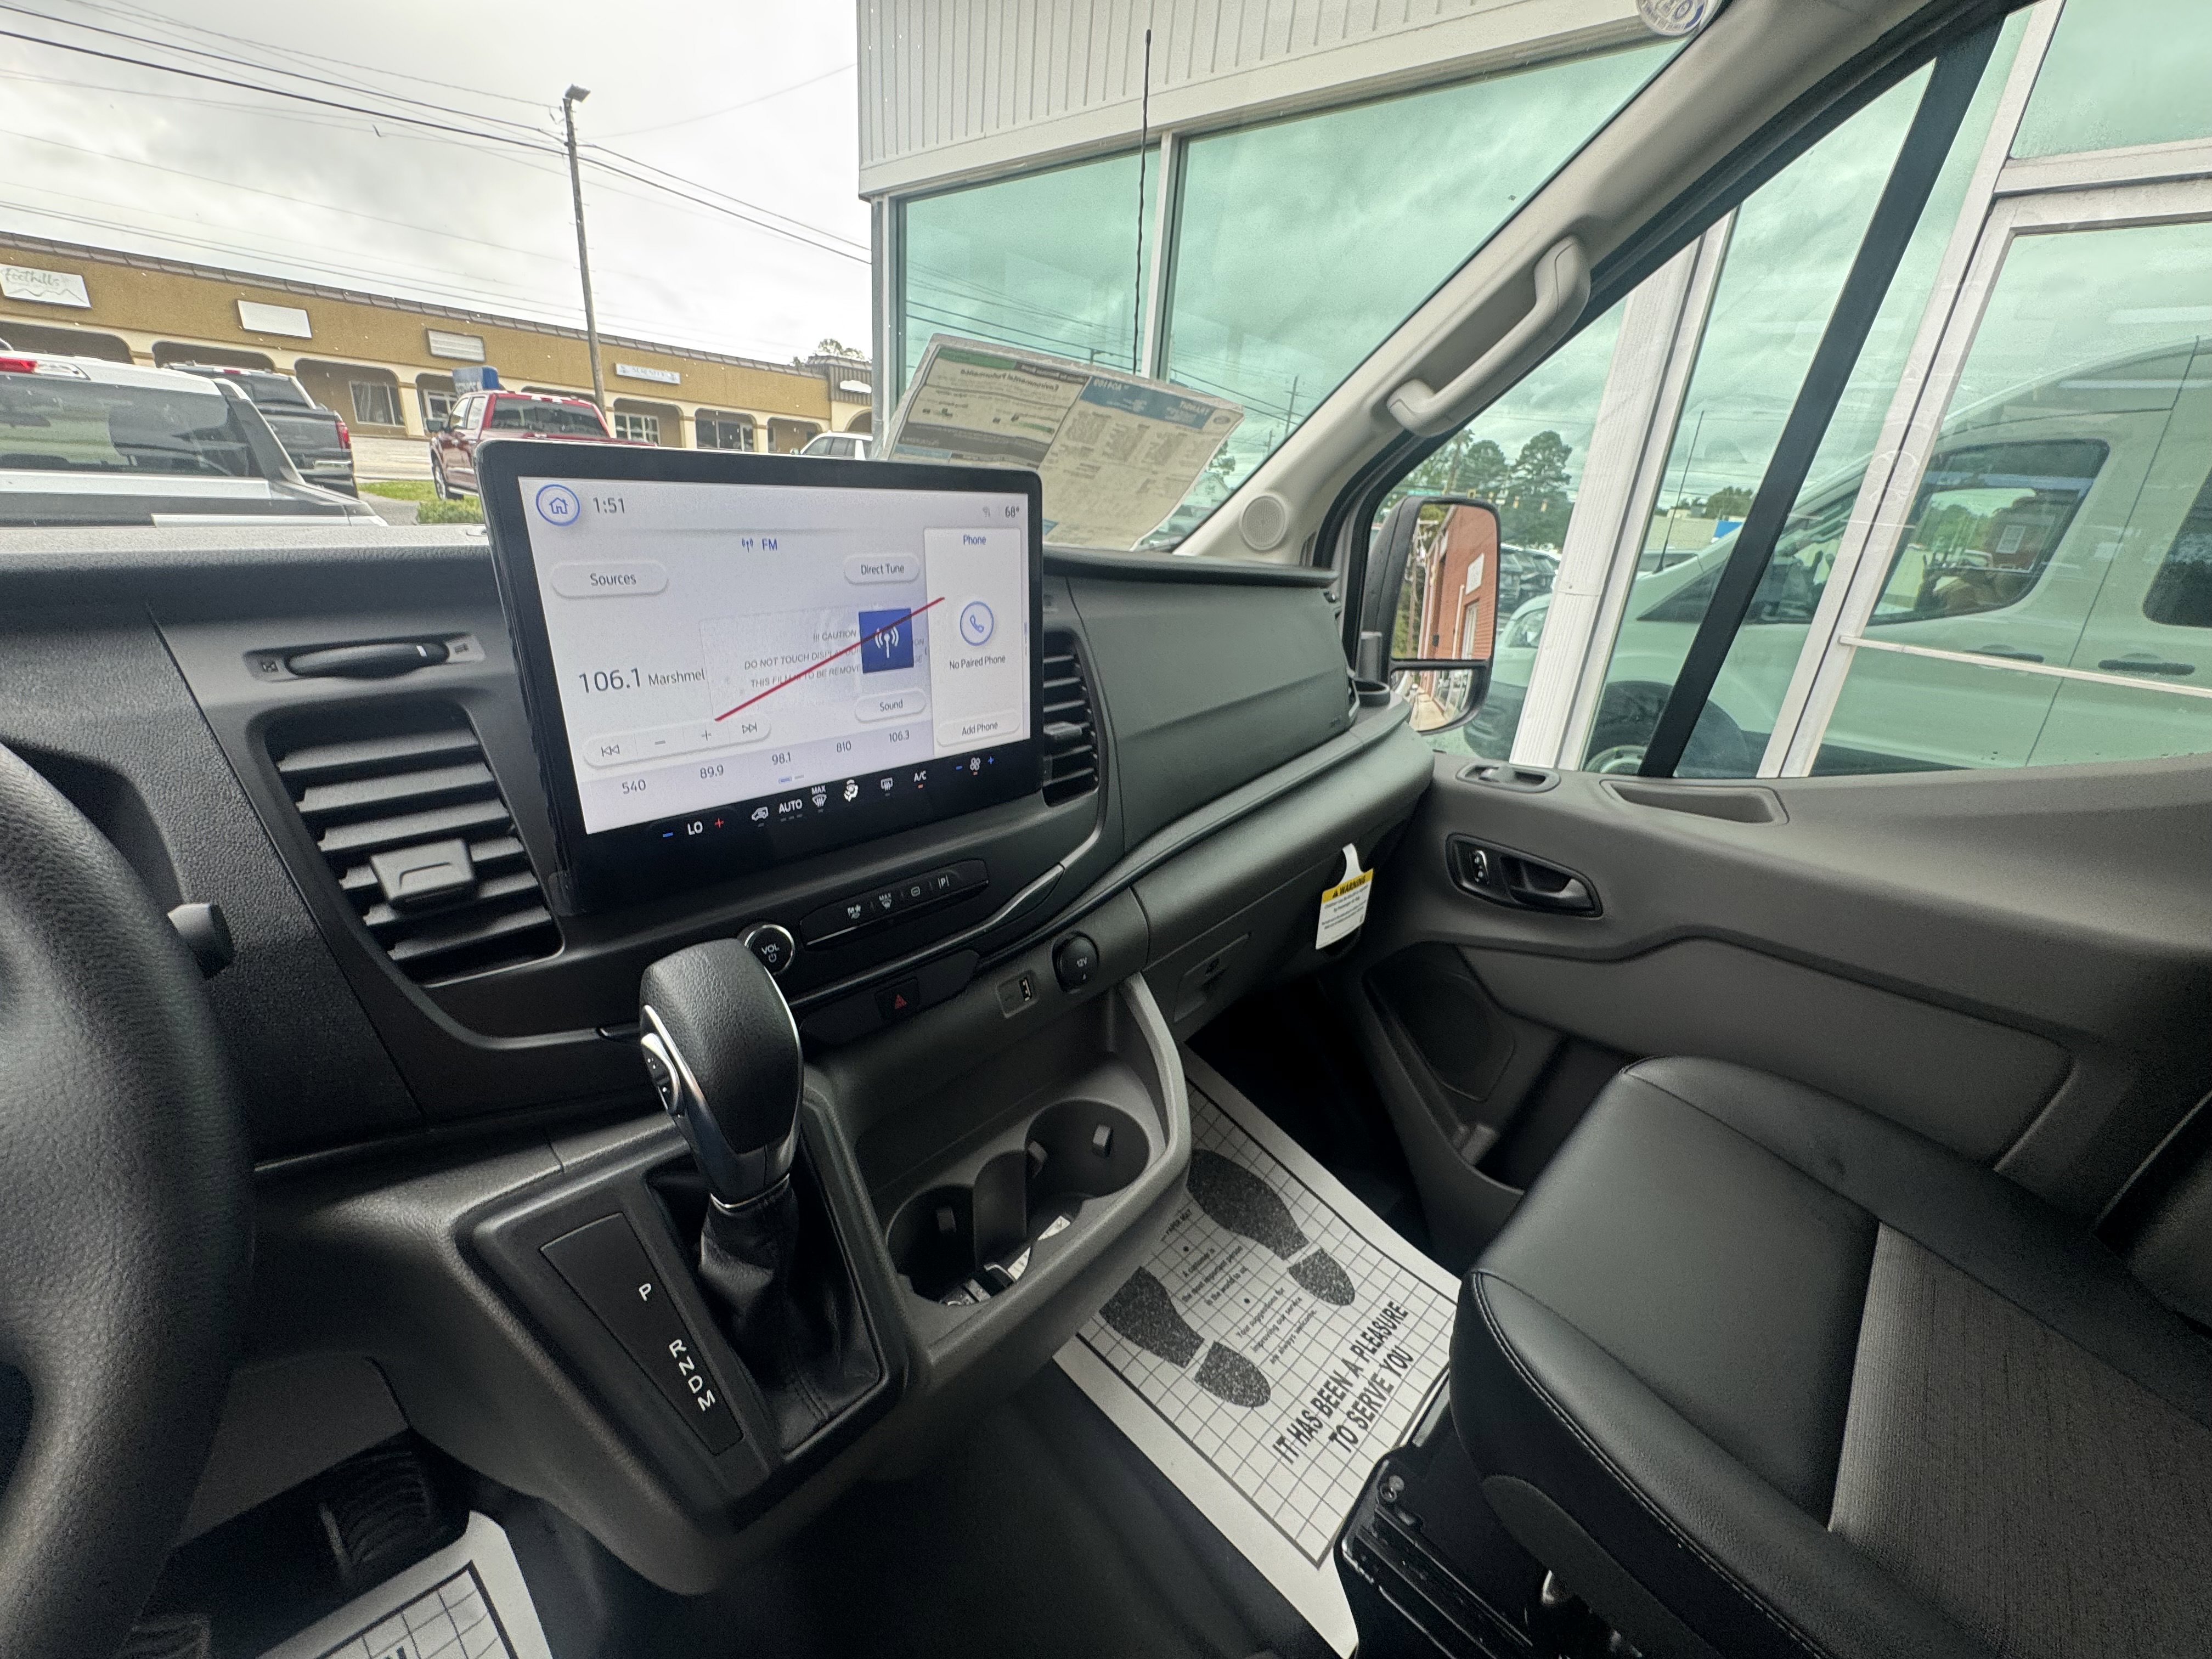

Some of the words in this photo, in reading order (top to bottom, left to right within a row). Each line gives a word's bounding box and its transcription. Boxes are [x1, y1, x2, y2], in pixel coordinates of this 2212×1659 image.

[593, 496, 625, 514] 1:51
[761, 538, 778, 551] FM
[963, 534, 986, 545] Phone
[861, 564, 884, 575] Direct
[885, 563, 905, 574] Tune
[590, 573, 637, 586] Sources
[822, 629, 856, 640] CAUTION
[744, 660, 758, 670] DO
[760, 657, 778, 668] NOT
[780, 653, 809, 666] TOUCH
[949, 661, 960, 670] No
[961, 658, 983, 668] Paired
[984, 655, 1006, 665] Phone
[579, 667, 641, 694] 106.1
[648, 668, 706, 686] Marshmel
[751, 678, 770, 688] THIS
[816, 668, 827, 678] BE
[879, 698, 904, 712] Sound
[962, 724, 975, 736] Add
[977, 721, 998, 735] Phone
[622, 778, 646, 795] 540
[700, 764, 724, 779] 89.9
[771, 752, 792, 766] 98.1
[836, 741, 851, 753] 810
[888, 729, 910, 743] 106.3
[913, 770, 927, 783] A/C
[811, 785, 826, 795] MAX
[687, 821, 703, 836] LO
[778, 799, 803, 814] AUTO
[1340, 874, 1365, 895] WARNING
[879, 893, 892, 901] MAX
[761, 943, 780, 955] VOL
[1076, 956, 1087, 968] 12V
[638, 1283, 652, 1301] P
[1276, 1314, 1286, 1325] our
[1350, 1300, 1408, 1364] PLEASURE
[669, 1339, 687, 1359] R
[679, 1356, 695, 1376] N
[1341, 1355, 1363, 1378] A
[688, 1375, 703, 1394] D
[1311, 1369, 1353, 1418] BEEN
[697, 1390, 716, 1412] M
[1329, 1423, 1359, 1454] TO
[1346, 1372, 1393, 1431] SERVE
[1380, 1344, 1413, 1380] YOU
[1287, 1408, 1323, 1446] HAS
[1273, 1435, 1301, 1464] IT
